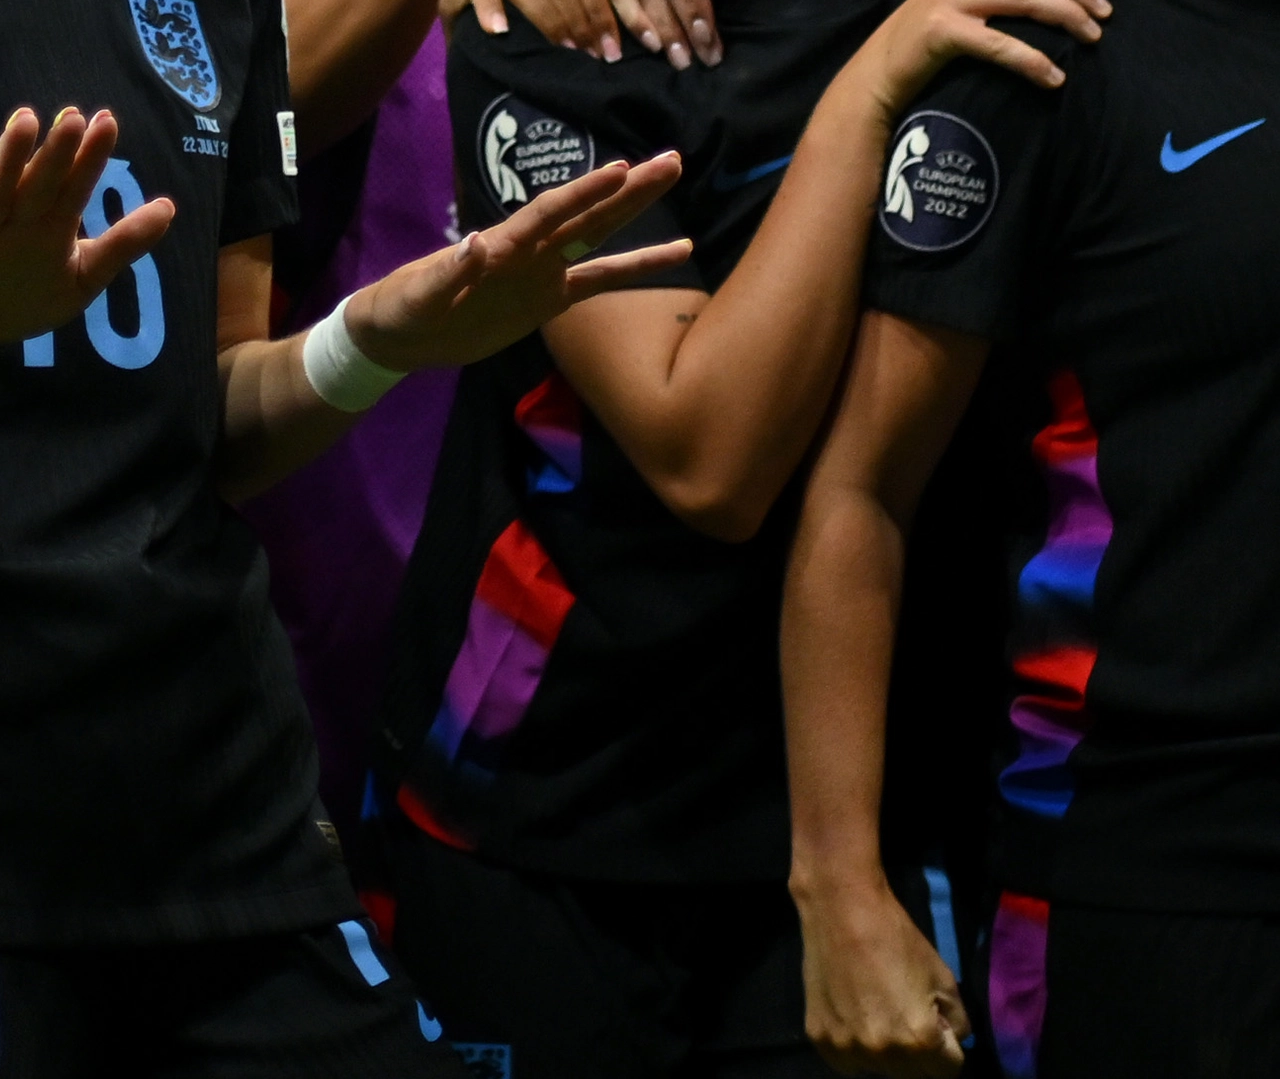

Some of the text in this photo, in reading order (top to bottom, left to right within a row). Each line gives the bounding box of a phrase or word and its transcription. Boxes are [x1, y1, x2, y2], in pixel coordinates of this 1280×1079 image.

[527, 120, 563, 140] UEFA
[182, 136, 197, 153] 22
[197, 138, 220, 156] JULY
[515, 138, 580, 157] EUROPEAN
[515, 150, 585, 171] CHAMPIONS
[936, 151, 975, 173] UEFA
[531, 167, 570, 185] 2022
[918, 167, 986, 190] EUROPEAN
[913, 179, 986, 203] CHAMPIONS
[924, 198, 968, 218] 2022
[23, 158, 166, 370] 8
